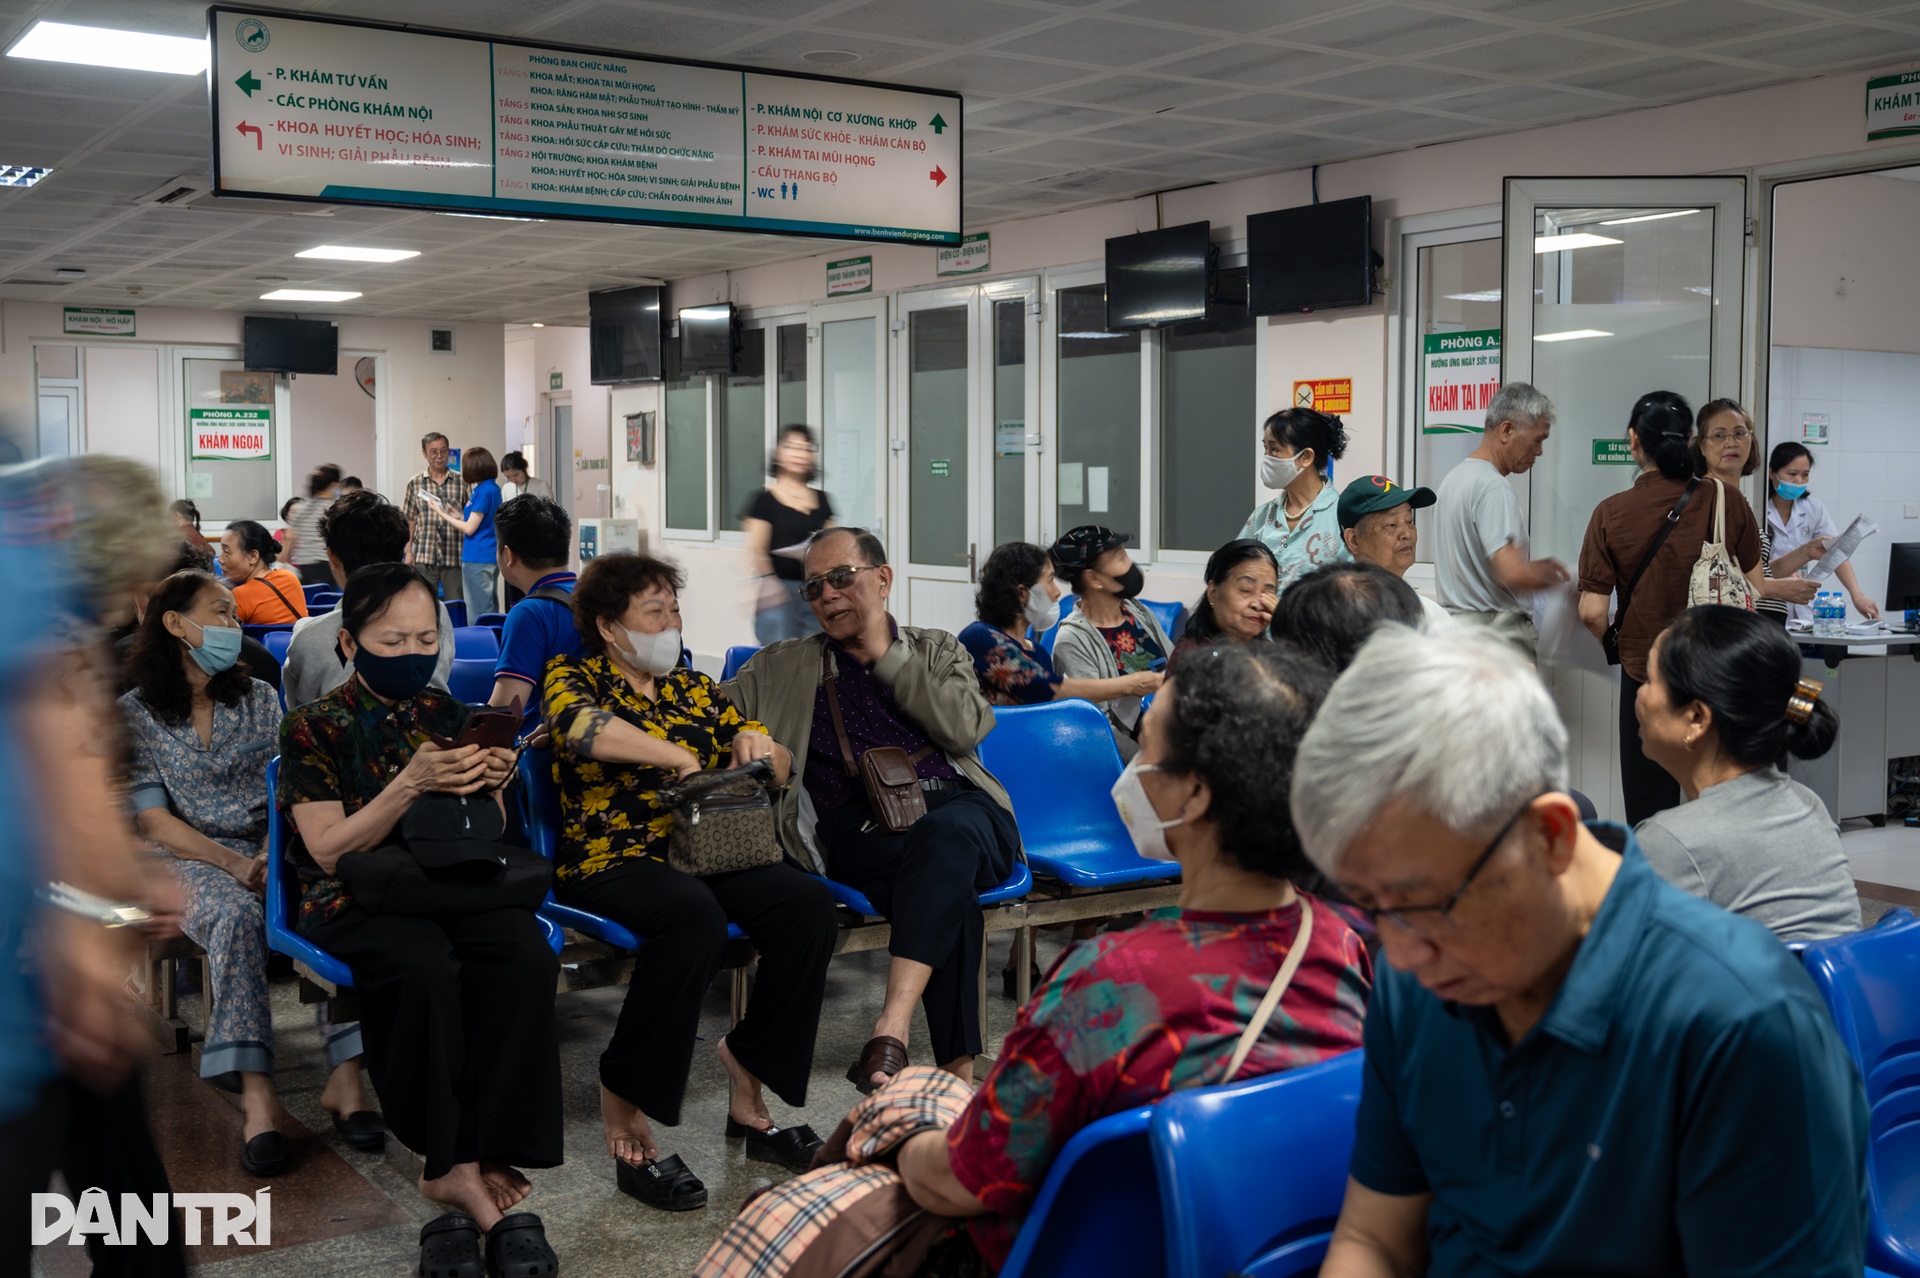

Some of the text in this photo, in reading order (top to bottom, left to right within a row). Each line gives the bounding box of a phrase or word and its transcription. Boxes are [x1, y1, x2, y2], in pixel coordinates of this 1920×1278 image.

[529, 55, 559, 66] PHÒNG
[560, 58, 577, 67] BAN
[579, 61, 602, 70] CHỨC
[603, 63, 627, 73] NĂNG
[276, 67, 387, 90] P. KHÁM TƯ VẤN
[522, 70, 529, 80] 6
[529, 71, 553, 81] KHOA
[555, 73, 575, 84] MẮT;
[576, 76, 599, 86] KHOA
[600, 79, 613, 87] TAI
[614, 80, 630, 89] MŨI
[631, 82, 655, 92] HỌNG
[276, 92, 432, 122] CÁC PHÒNG KHÁM NỘI
[524, 101, 529, 109] 5
[530, 102, 554, 112] KHOA
[576, 107, 599, 116] KHOA
[601, 109, 615, 118] NHI
[617, 111, 628, 119] SƠ
[629, 112, 648, 121] SINH
[530, 86, 555, 96] KHOA:
[579, 90, 600, 100] HÀM
[640, 97, 665, 108] THUẬT
[665, 100, 681, 110] TẠO
[682, 101, 700, 111] HÌNH
[725, 106, 739, 115] MỸ
[1874, 92, 1912, 112] KHÁM
[757, 103, 917, 130] P. KHÁM NỘI CƠ XƯƠNG KHỚP
[1904, 113, 1916, 121] Ear
[277, 119, 480, 150] KHOA HUYẾT HỌC; HÓA SINH;
[530, 118, 554, 128] KHOA
[580, 123, 608, 134] THUẬT
[655, 130, 671, 139] SỨC
[757, 124, 926, 153] P. KHÁM SỨC KHỎE KHÁM CÁN BỘ
[278, 143, 367, 161] VI SINH; GIẢI
[531, 134, 557, 144] KHOA:
[575, 138, 591, 147] SỨC
[610, 141, 630, 151] CỨU;
[630, 143, 654, 153] THĂM
[655, 145, 667, 154] DÒ
[668, 147, 690, 157] CHỨC
[691, 149, 714, 159] NĂNG
[758, 145, 875, 167] P. KHÁM TAI MŨI HỌNG
[524, 150, 529, 158] 2
[531, 150, 546, 161] HỘI
[547, 152, 584, 164] TRƯỜNG;
[586, 156, 609, 165] KHOA
[610, 157, 634, 167] KHÁM
[636, 159, 657, 170] BỆNH
[531, 166, 557, 175] KHOA:
[558, 168, 586, 177] HUYẾT
[587, 170, 607, 180] HỌC;
[608, 172, 626, 181] HÓA
[627, 174, 648, 184] SINH;
[649, 176, 657, 184] VI
[658, 176, 679, 186] SINH;
[680, 177, 696, 187] GIẢI
[720, 181, 740, 191] BỆNH
[757, 164, 837, 186] CẦU THANG BỘ
[531, 182, 557, 191] KHOA:
[558, 184, 583, 194] KHÁM
[584, 185, 609, 196] BỆNH;
[627, 189, 646, 199] CỨU;
[671, 193, 694, 202] ĐOÁN
[695, 194, 714, 204] HÌNH
[757, 187, 774, 198] WC
[854, 228, 944, 241] www.benhvienducgiang.com
[69, 314, 88, 323] KHÁM
[1440, 335, 1500, 349] PHÒNG A.
[1461, 355, 1475, 366] NGÀY
[1476, 355, 1488, 365] SỨC
[1326, 382, 1334, 394] HÚT
[1335, 380, 1349, 394] THUỐC
[1429, 379, 1476, 411] KHÁM TAI
[1324, 398, 1349, 411] SMOKING
[199, 431, 263, 453] KHÁM NGOẠI
[1608, 453, 1625, 461] KHÔNG
